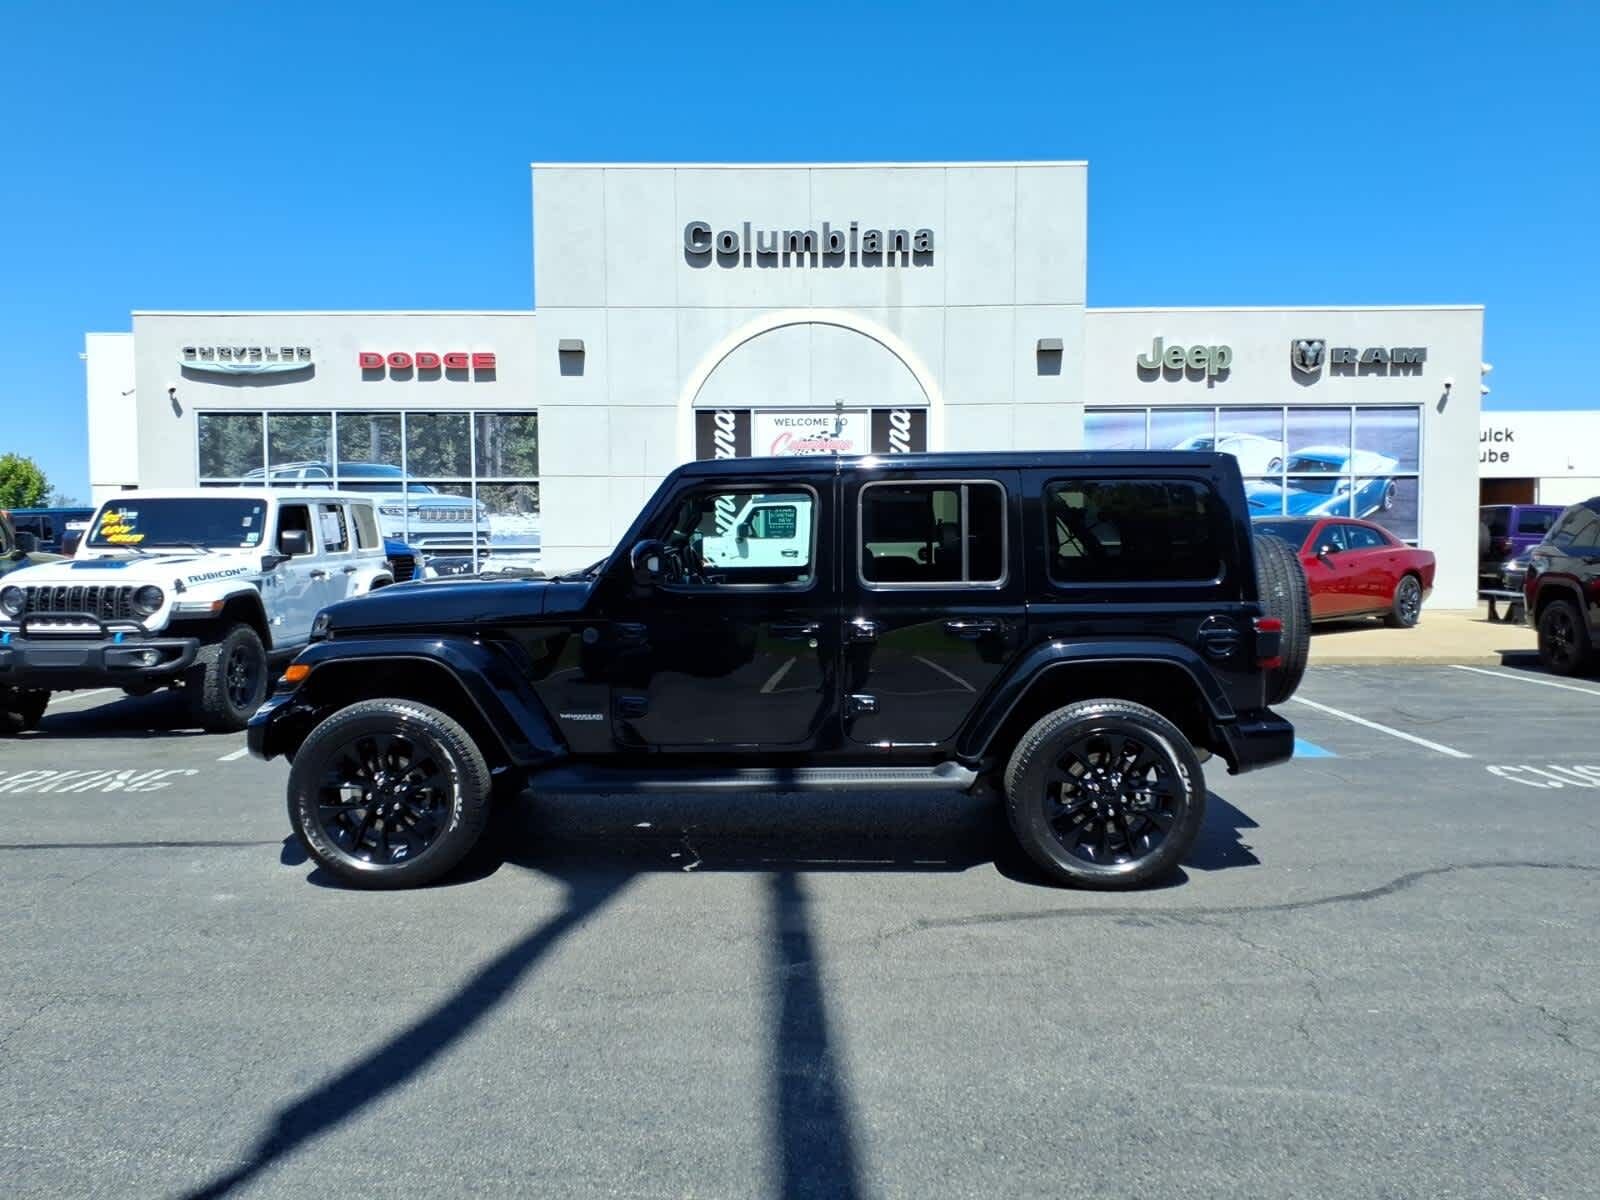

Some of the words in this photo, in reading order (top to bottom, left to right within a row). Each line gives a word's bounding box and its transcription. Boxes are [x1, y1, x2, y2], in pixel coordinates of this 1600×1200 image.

[684, 221, 935, 255] Columbiana
[182, 346, 311, 361] CHRYSLER
[359, 352, 496, 370] DODGE
[1137, 336, 1233, 375] Jeep
[1330, 347, 1427, 365] RAM
[774, 417, 829, 427] WELCOME
[187, 568, 241, 583] RUBICON
